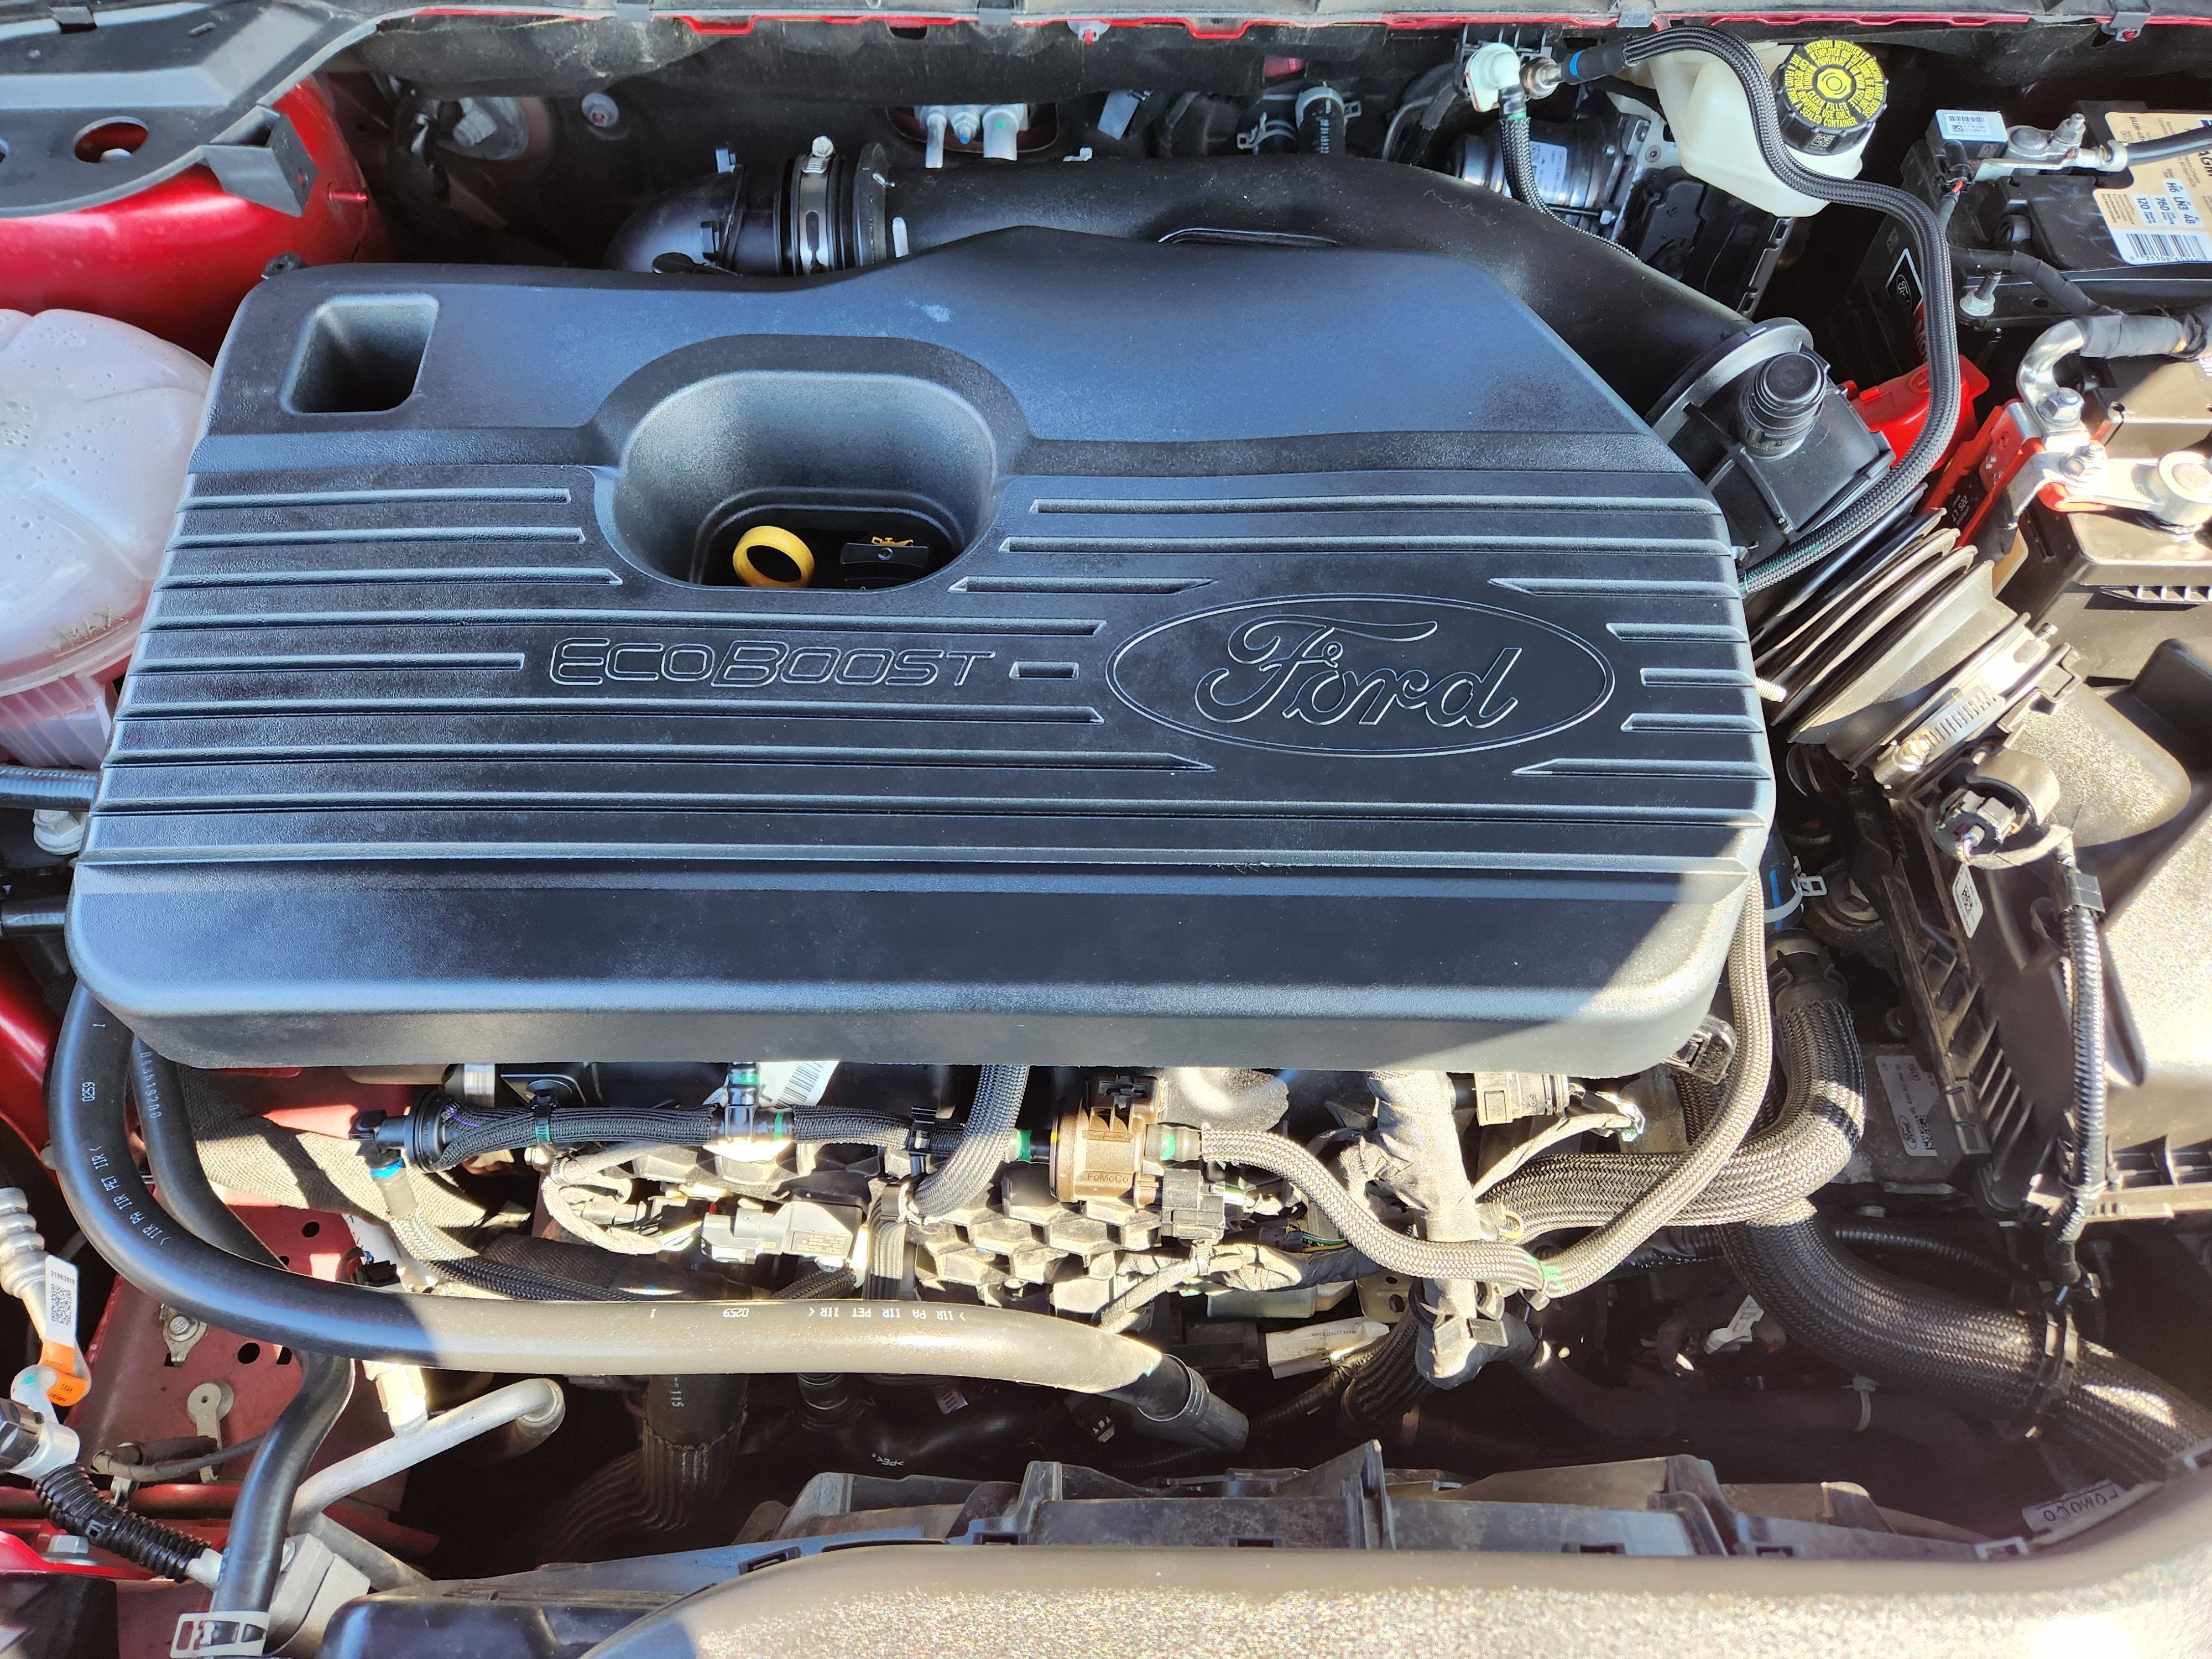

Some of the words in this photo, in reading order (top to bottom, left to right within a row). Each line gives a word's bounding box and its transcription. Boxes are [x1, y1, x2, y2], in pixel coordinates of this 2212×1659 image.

[1804, 40, 1833, 54] ATTENTION
[1834, 40, 1862, 55] NETTOYER
[1860, 51, 1870, 61] LE
[1796, 59, 1809, 73] CAP
[1865, 58, 1883, 82] BOUCHON
[1794, 70, 1804, 90] BEFORE
[1803, 65, 1818, 90] WARNING
[1815, 56, 1847, 67] PROVENANT
[1848, 89, 1865, 107] SCELLE
[1841, 49, 1853, 59] QUE
[1865, 86, 1874, 101] FREIN
[1806, 91, 1825, 107] CLEAN
[1875, 83, 1884, 100] AVANT
[1787, 88, 1797, 104] FROM
[1799, 107, 1822, 124] SEALED
[1823, 117, 1858, 128] CONTAINER
[1797, 91, 1822, 114] REMOVING
[1826, 102, 1849, 111] FILLER
[1861, 100, 1880, 119] DEPOSE
[1822, 111, 1834, 119] USE
[1835, 110, 1851, 119] ONLY
[2136, 197, 2151, 210] 120
[2155, 197, 2170, 211] 760
[2166, 182, 2180, 193] H6
[2173, 197, 2189, 210] LN3
[2183, 214, 2195, 224] 48
[1194, 614, 1523, 729] Ford
[81, 1081, 96, 1103] 0259
[1087, 1172, 1129, 1183] FoMoCo
[722, 1306, 749, 1318] 0259
[852, 1307, 872, 1319] PET
[912, 1308, 927, 1320] PA
